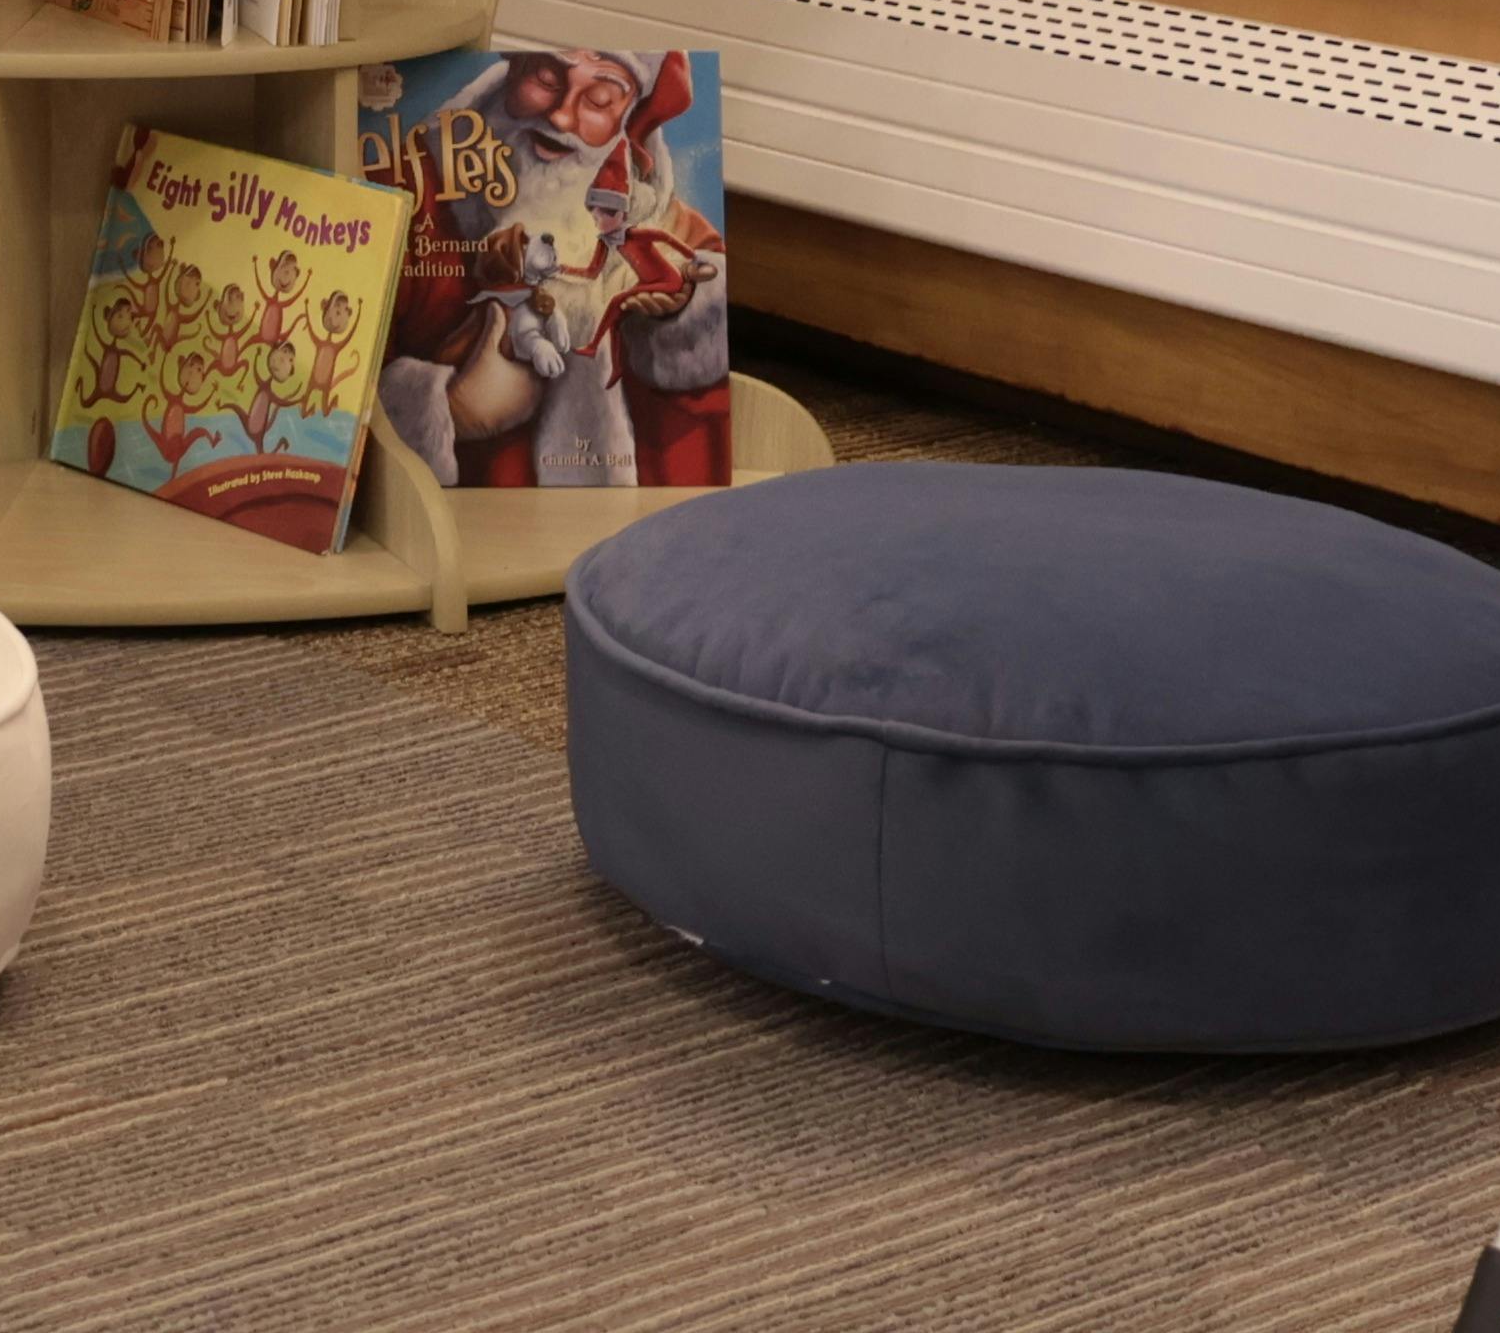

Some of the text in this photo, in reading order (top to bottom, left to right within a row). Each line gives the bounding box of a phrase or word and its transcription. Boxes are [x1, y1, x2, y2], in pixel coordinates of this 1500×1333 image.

[435, 108, 519, 208] Pets
[146, 160, 372, 253] Eight Silly Monkeys
[414, 213, 434, 233] A
[415, 235, 489, 257] Bernard
[575, 436, 593, 452] by
[208, 474, 249, 497] Illustrated
[250, 473, 260, 485] by
